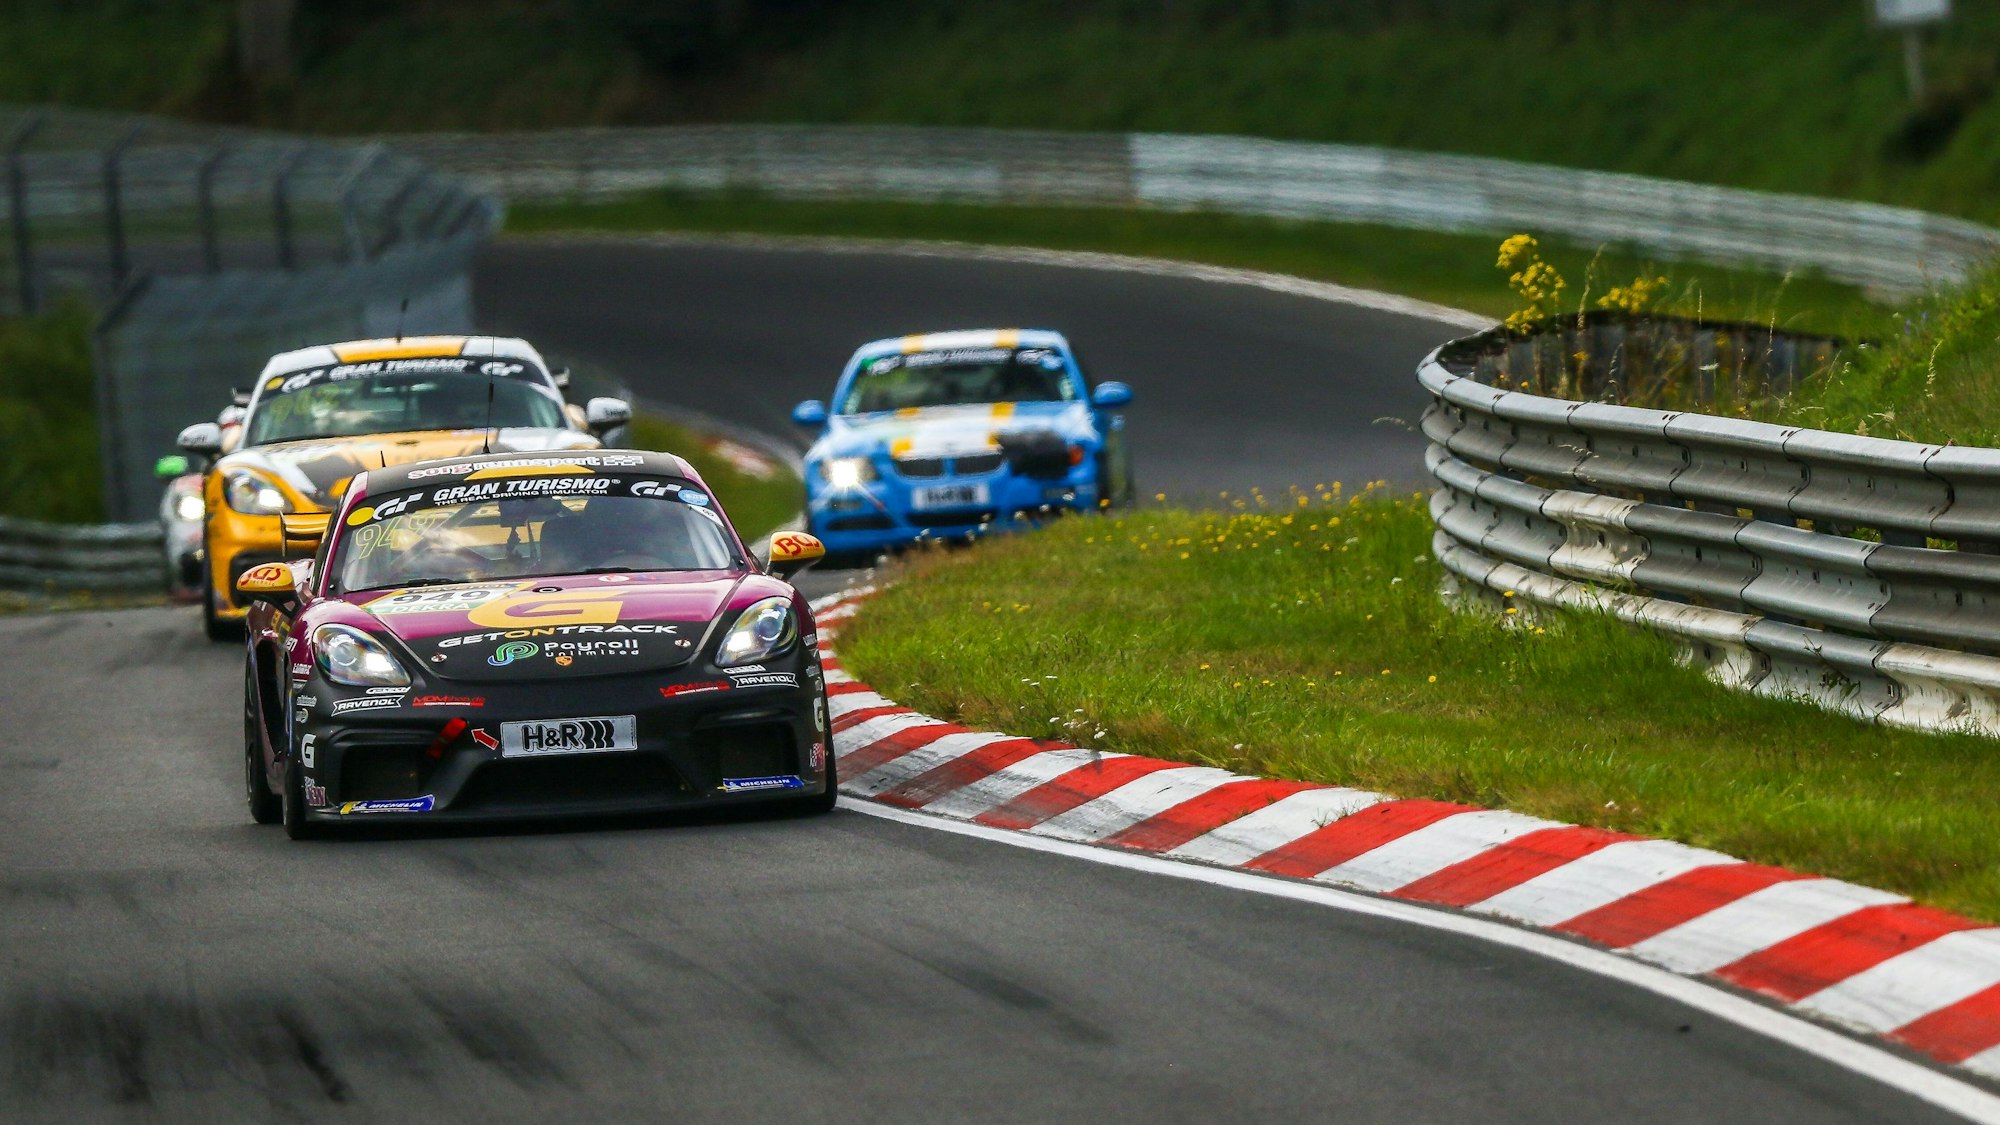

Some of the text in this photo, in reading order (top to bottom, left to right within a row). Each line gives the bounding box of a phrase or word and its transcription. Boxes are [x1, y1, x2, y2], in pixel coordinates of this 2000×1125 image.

[329, 361, 383, 380] GRAN
[433, 482, 501, 501] GRAN
[460, 495, 491, 503] REAL
[493, 489, 540, 498] DRIVING
[393, 590, 491, 605] 949
[391, 602, 470, 614] DEKRA
[523, 721, 582, 752] H&R
[301, 733, 317, 769] G
[740, 778, 791, 787] MICHELIN
[368, 801, 425, 809] MICHELIN
